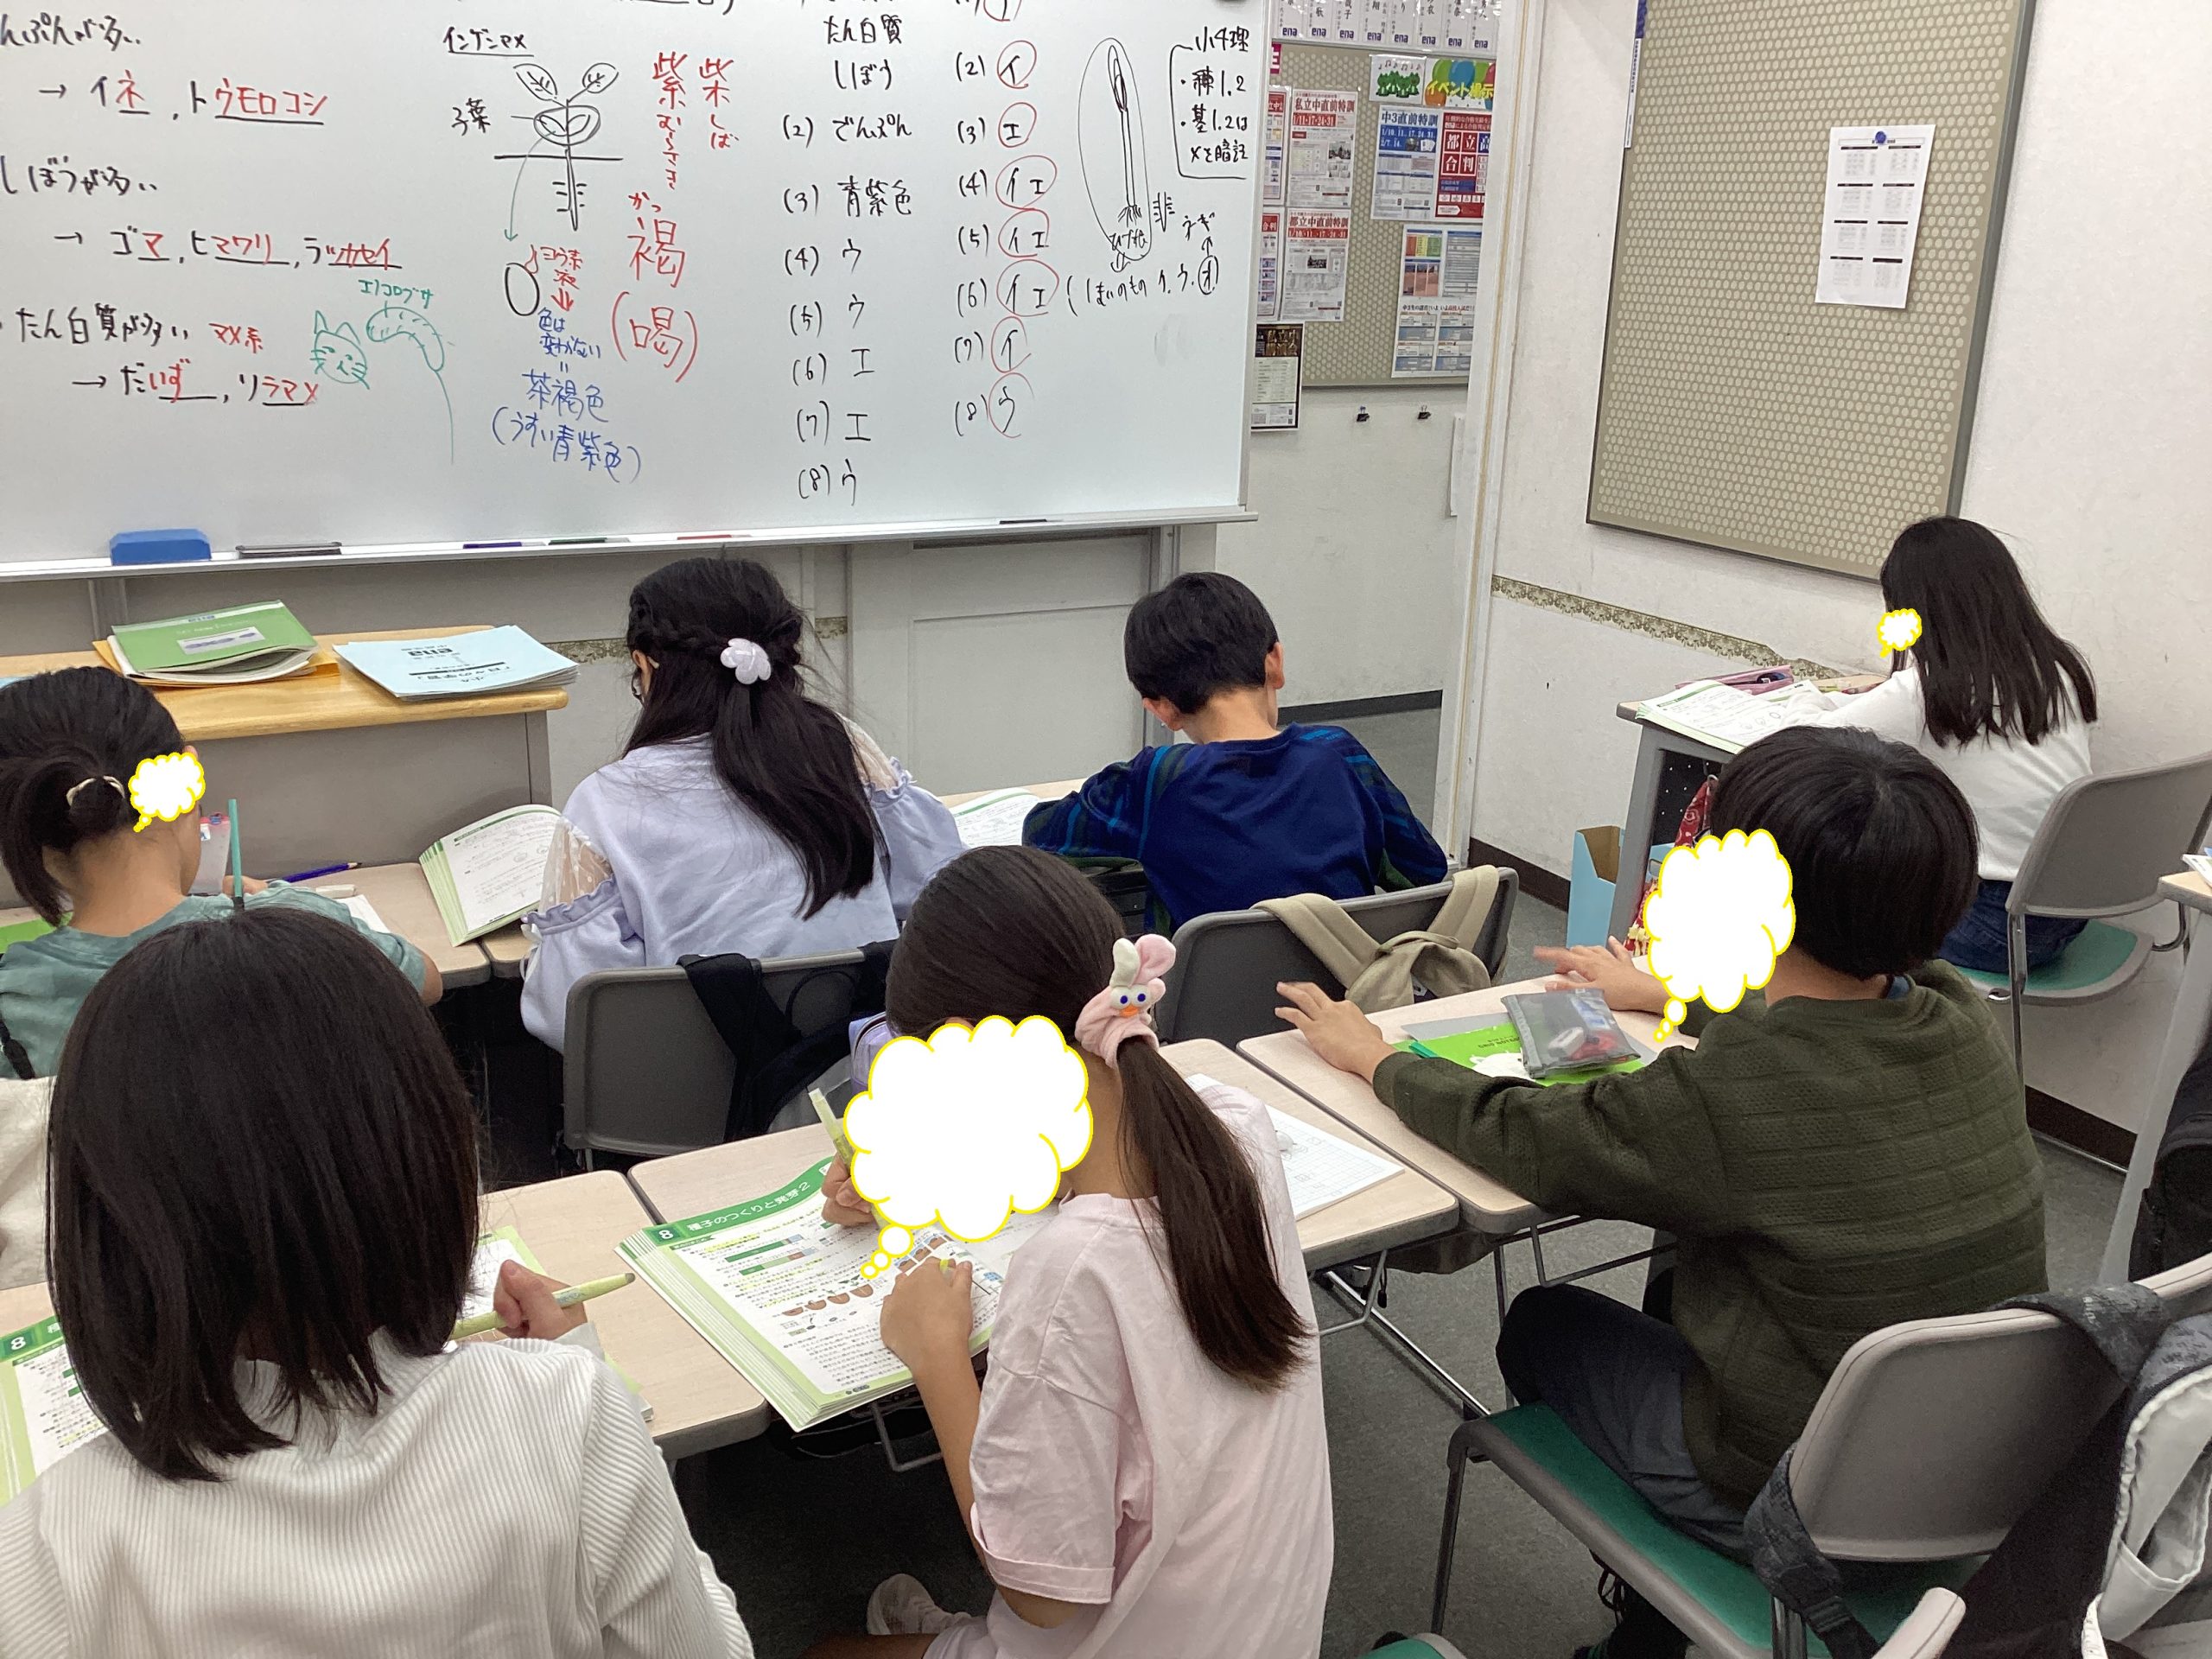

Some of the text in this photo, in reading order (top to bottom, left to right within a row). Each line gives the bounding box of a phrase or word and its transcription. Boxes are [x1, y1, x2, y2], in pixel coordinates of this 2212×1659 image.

[823, 14, 902, 44] たん白質
[1282, 28, 1297, 36] ena
[1312, 28, 1326, 36] ena
[1339, 30, 1354, 39] ena
[1367, 32, 1382, 41] ena
[1395, 34, 1408, 43] ena
[1448, 37, 1462, 47] ena
[1474, 40, 1488, 48] ena
[835, 59, 893, 90] しぼう
[1427, 80, 1493, 99] イベント掲示
[783, 113, 912, 148] (2) でんぷん
[957, 118, 986, 145] (3)
[1381, 111, 1439, 126] 中3直前特訓
[784, 175, 912, 217] (3) 青紫色
[959, 168, 988, 198] (4)
[958, 224, 988, 257] (5)
[785, 245, 819, 276] (4)
[957, 278, 987, 317] (6)
[790, 301, 823, 337] (5)
[955, 332, 984, 363] (7)
[792, 353, 827, 386] (6)
[797, 400, 829, 446] (7)
[955, 394, 988, 437] (8)
[798, 464, 830, 499] (8)
[660, 1226, 674, 1241] 8
[10, 1336, 26, 1351] 8
